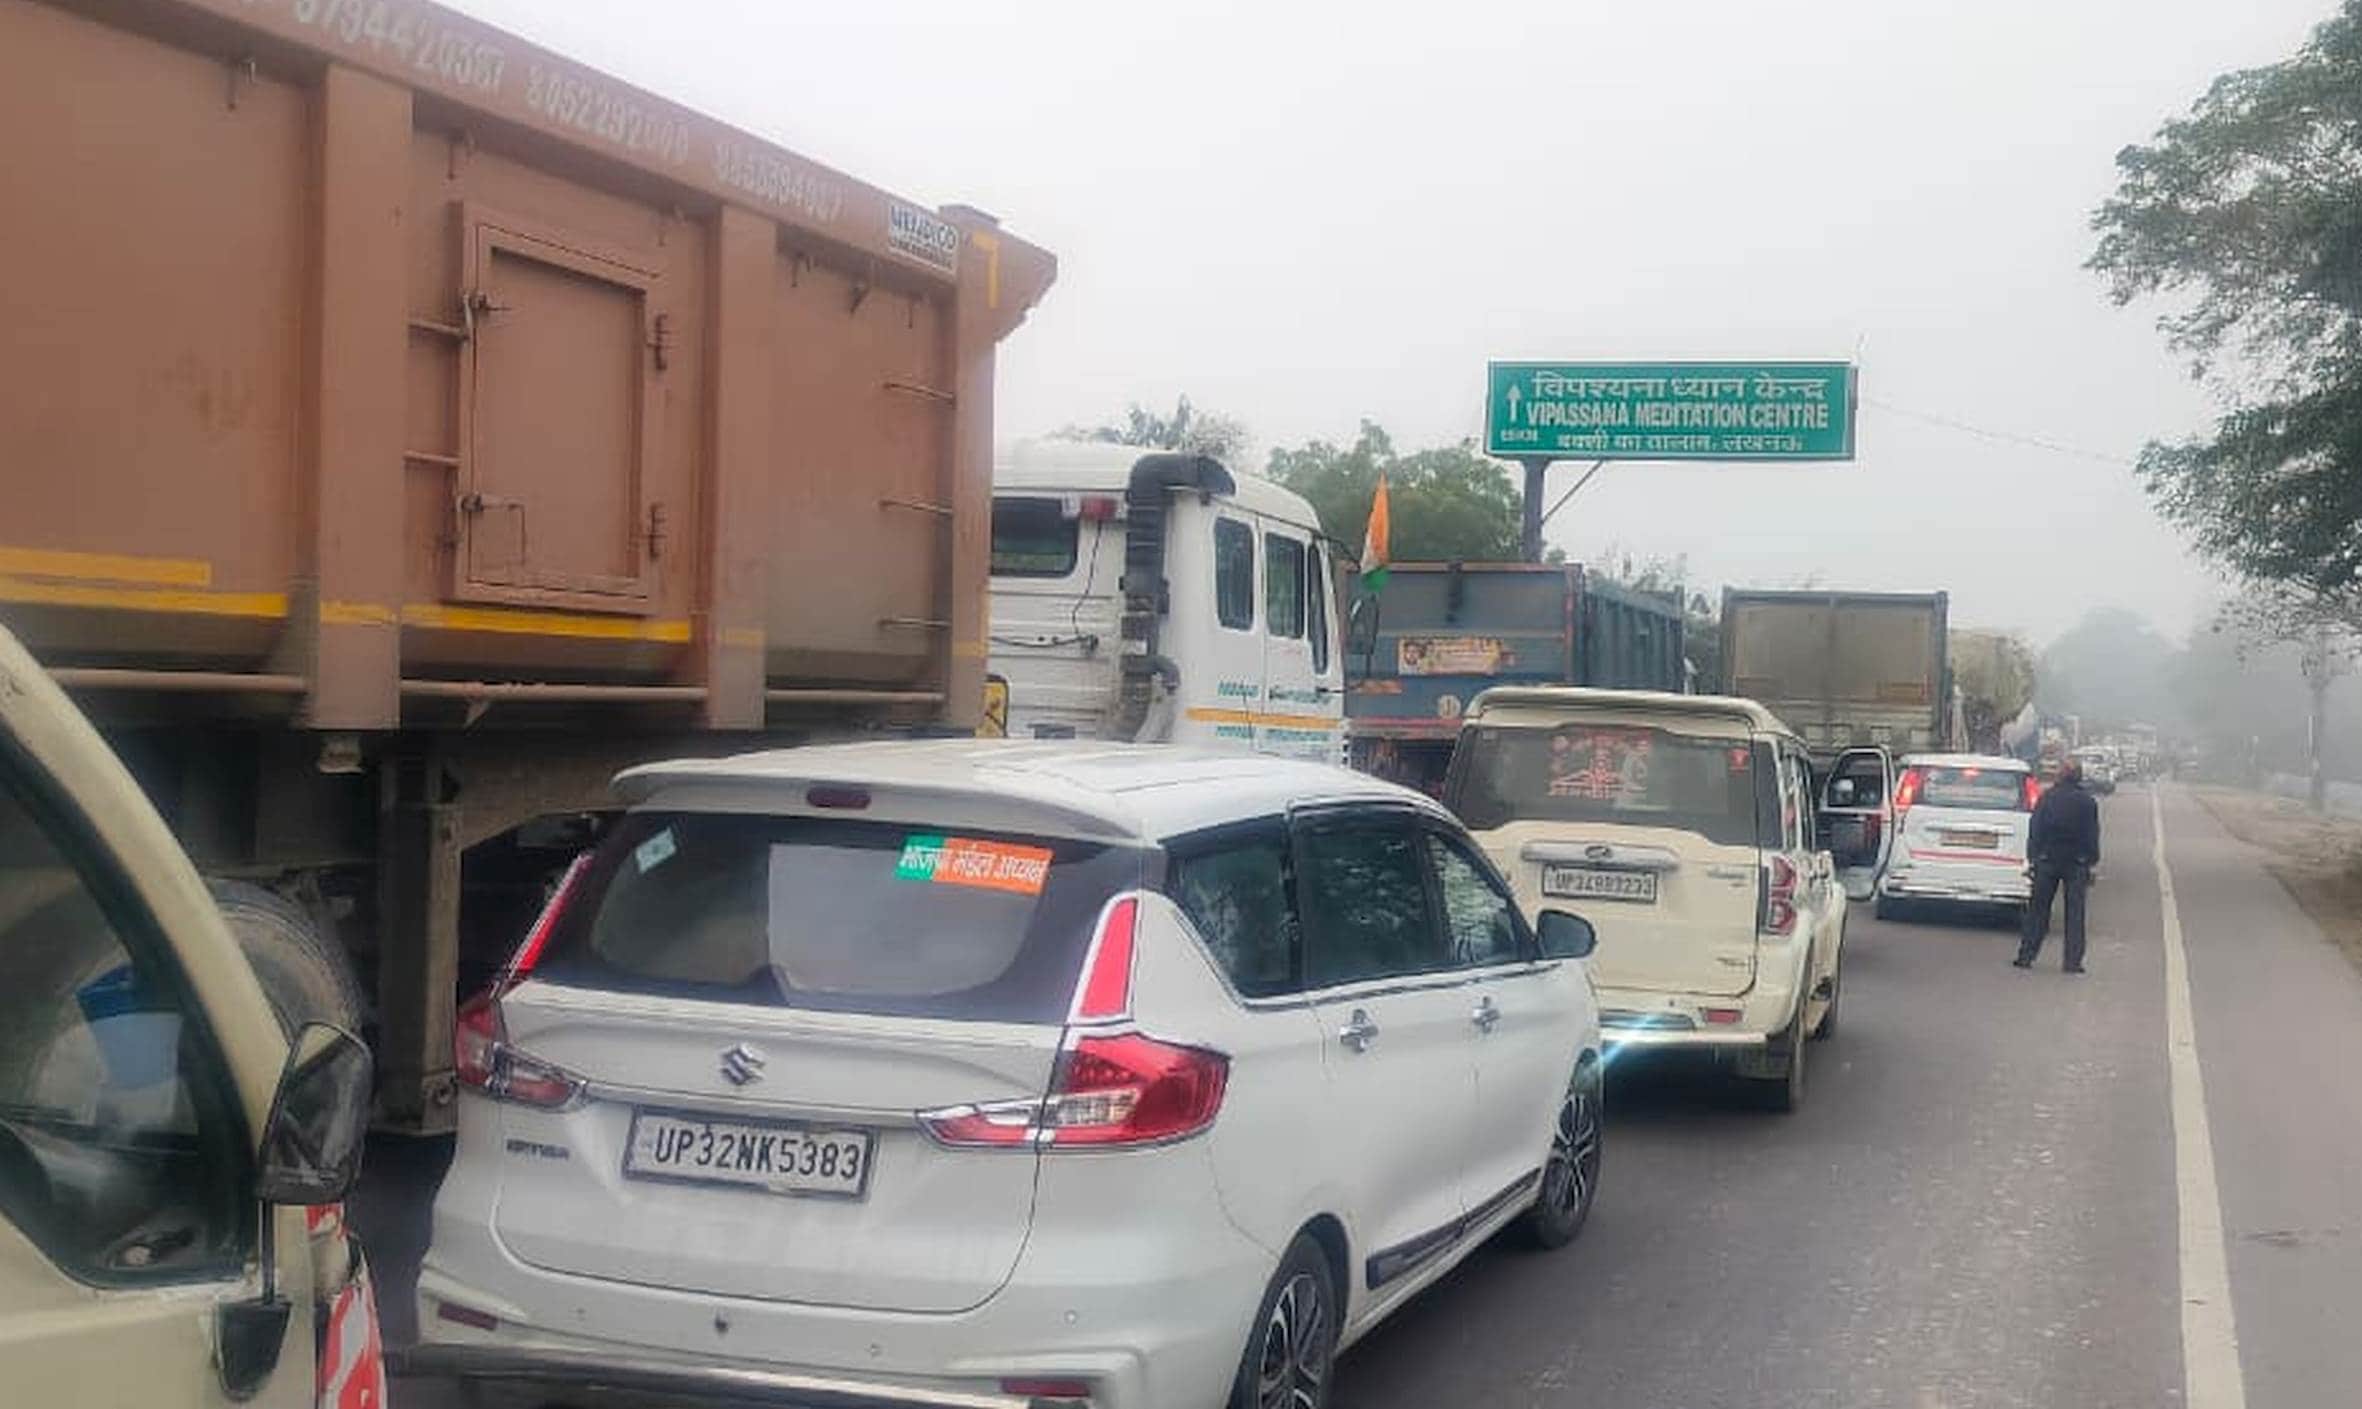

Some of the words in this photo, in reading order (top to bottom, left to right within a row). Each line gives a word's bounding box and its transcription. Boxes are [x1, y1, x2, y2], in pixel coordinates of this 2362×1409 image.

[1531, 371, 1667, 398] विपश्यना
[1671, 378, 1745, 398] ध्यान
[1526, 401, 1629, 427] VIPASSANA
[1635, 402, 1746, 428] MEDITATION
[1751, 402, 1829, 428] CENTRE
[655, 1125, 860, 1179] UP32NK5383
